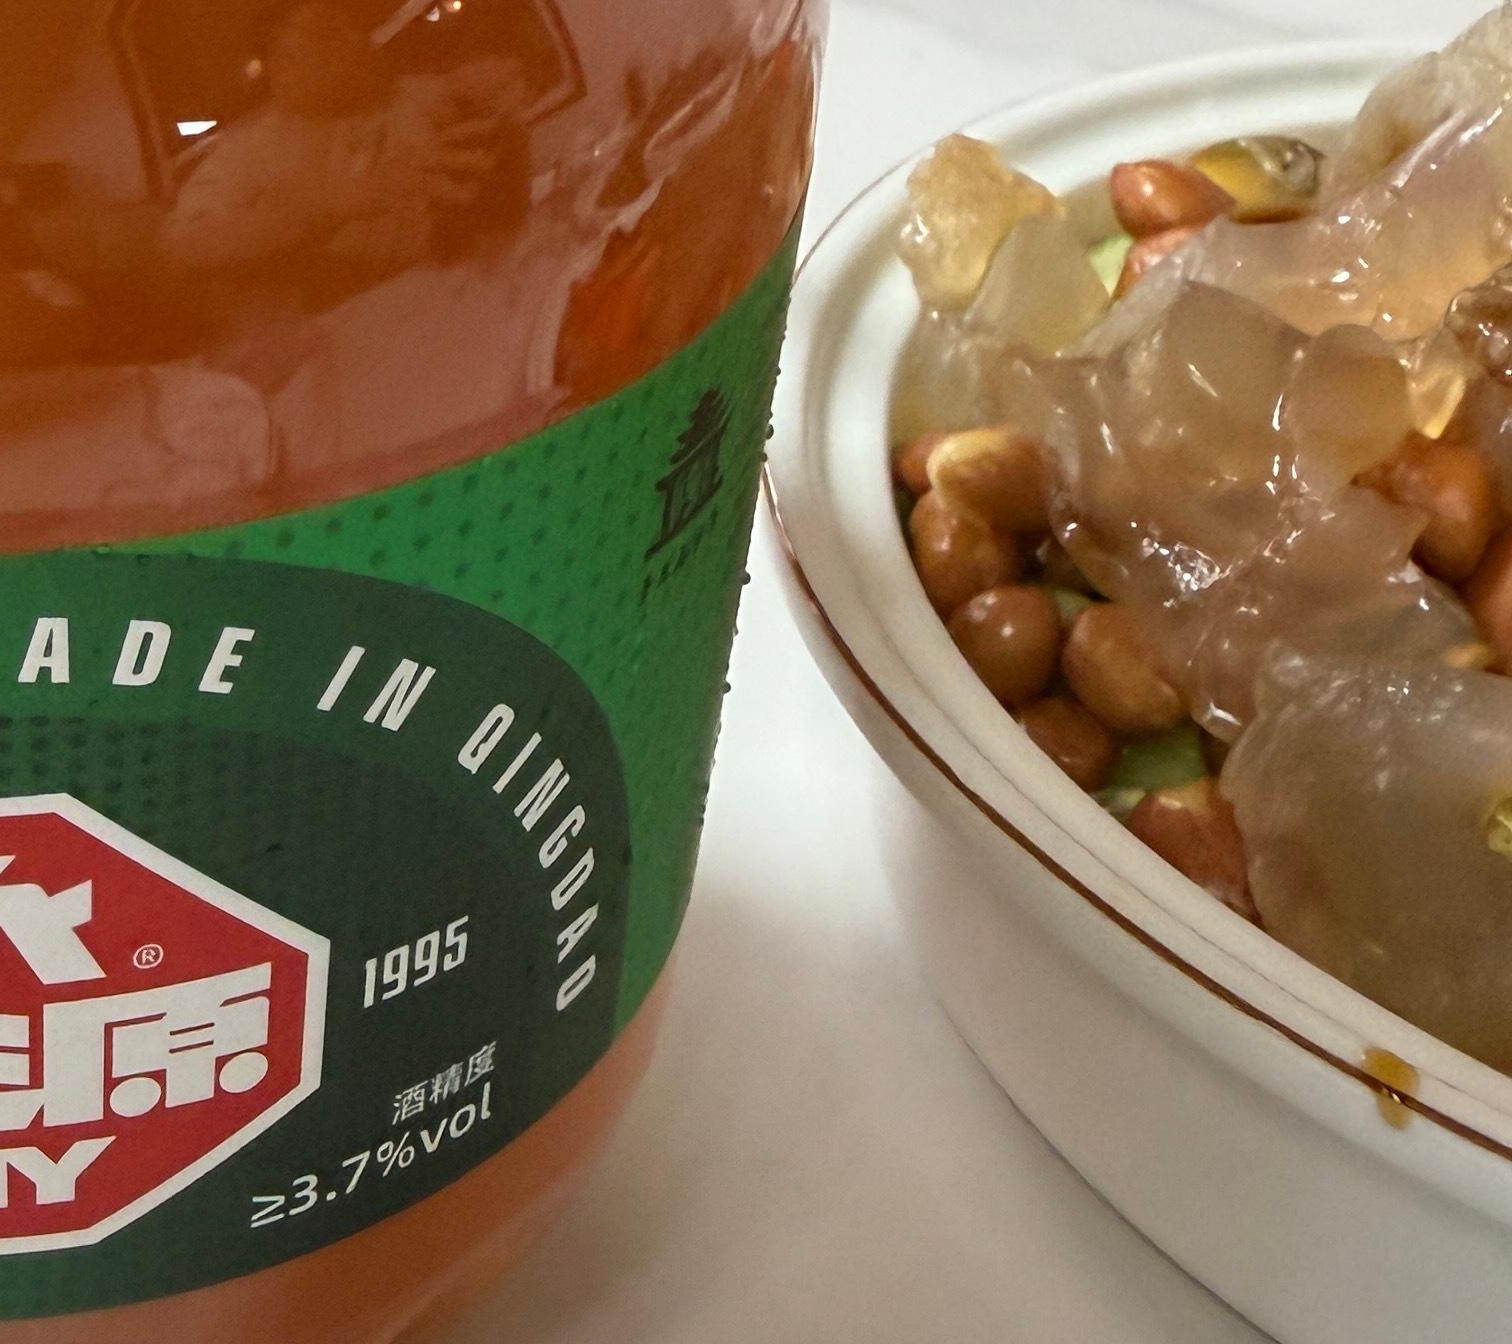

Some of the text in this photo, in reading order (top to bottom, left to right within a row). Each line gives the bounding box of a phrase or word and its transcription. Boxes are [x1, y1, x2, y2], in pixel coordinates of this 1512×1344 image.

[317, 646, 436, 731] IN
[458, 703, 599, 1012] QINGDAO
[363, 915, 469, 1008] 1995
[392, 1041, 497, 1125] 酒精度
